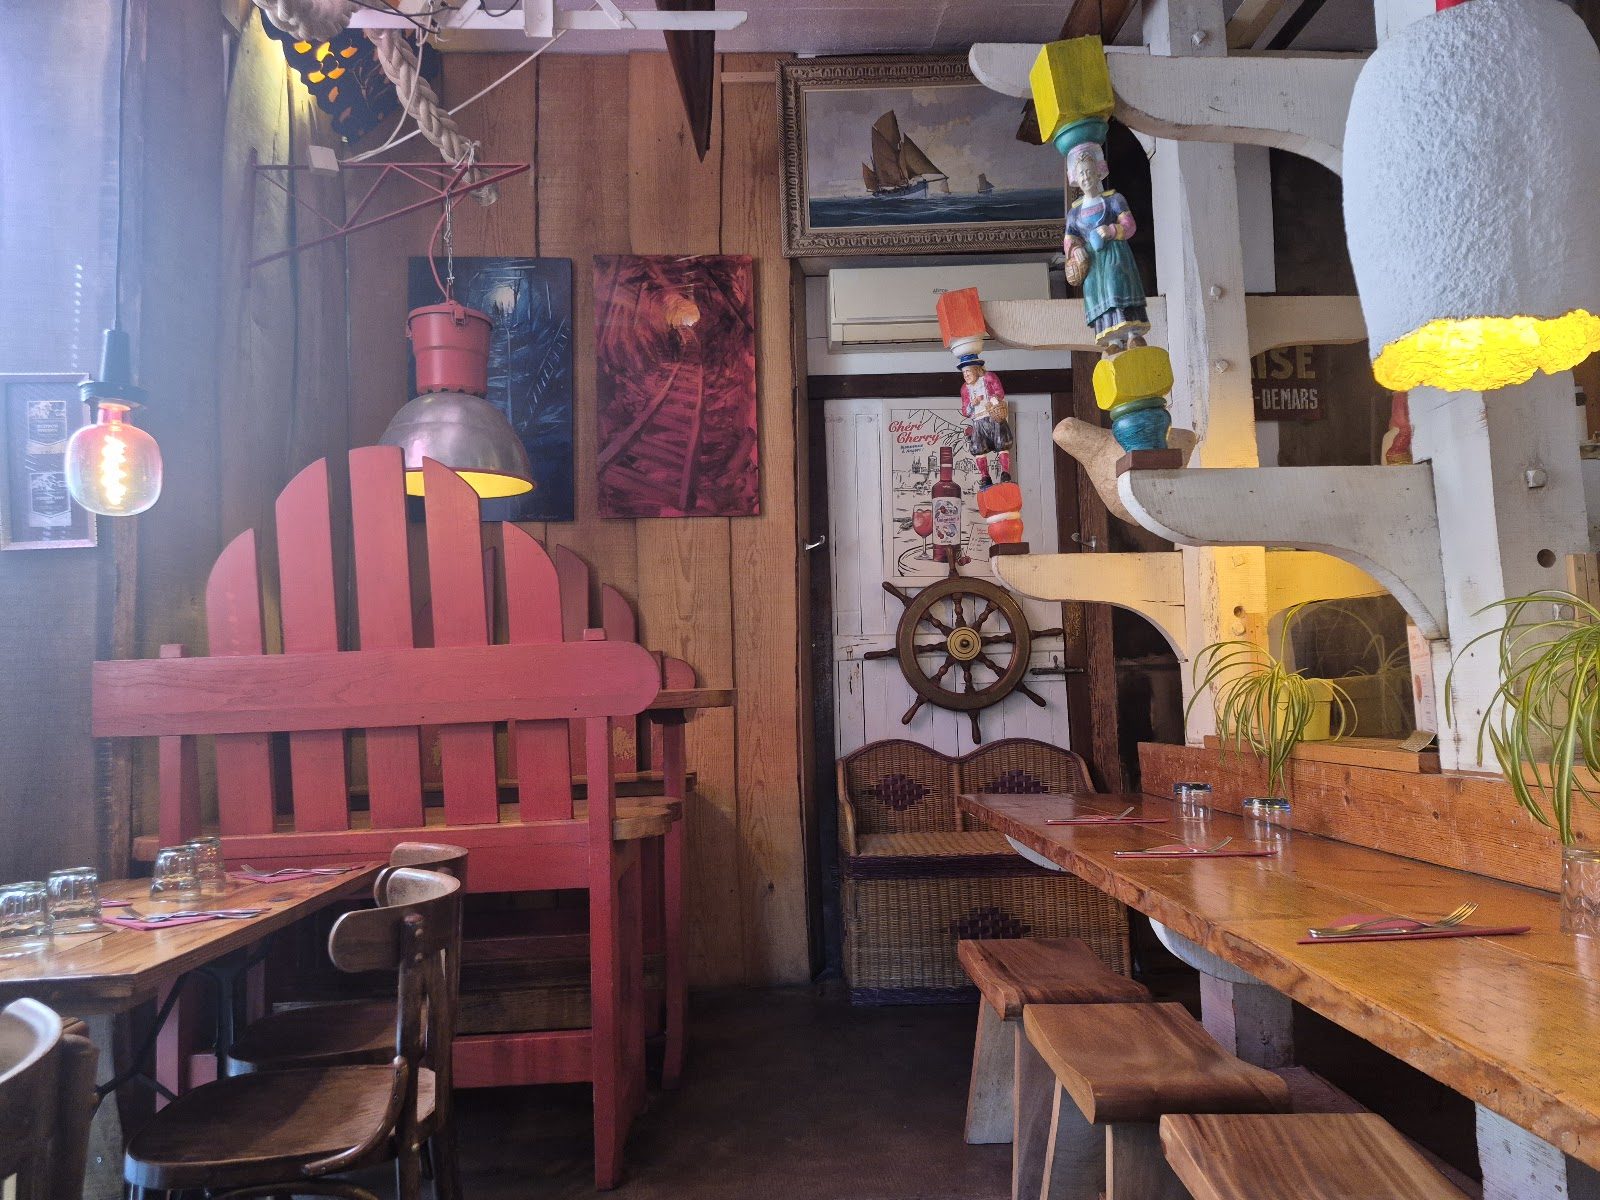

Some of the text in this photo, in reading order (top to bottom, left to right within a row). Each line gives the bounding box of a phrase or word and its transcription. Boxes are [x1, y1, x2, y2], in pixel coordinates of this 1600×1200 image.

[1251, 346, 1316, 379] ISE
[888, 420, 924, 433] Chéri
[897, 432, 940, 445] Cherry
